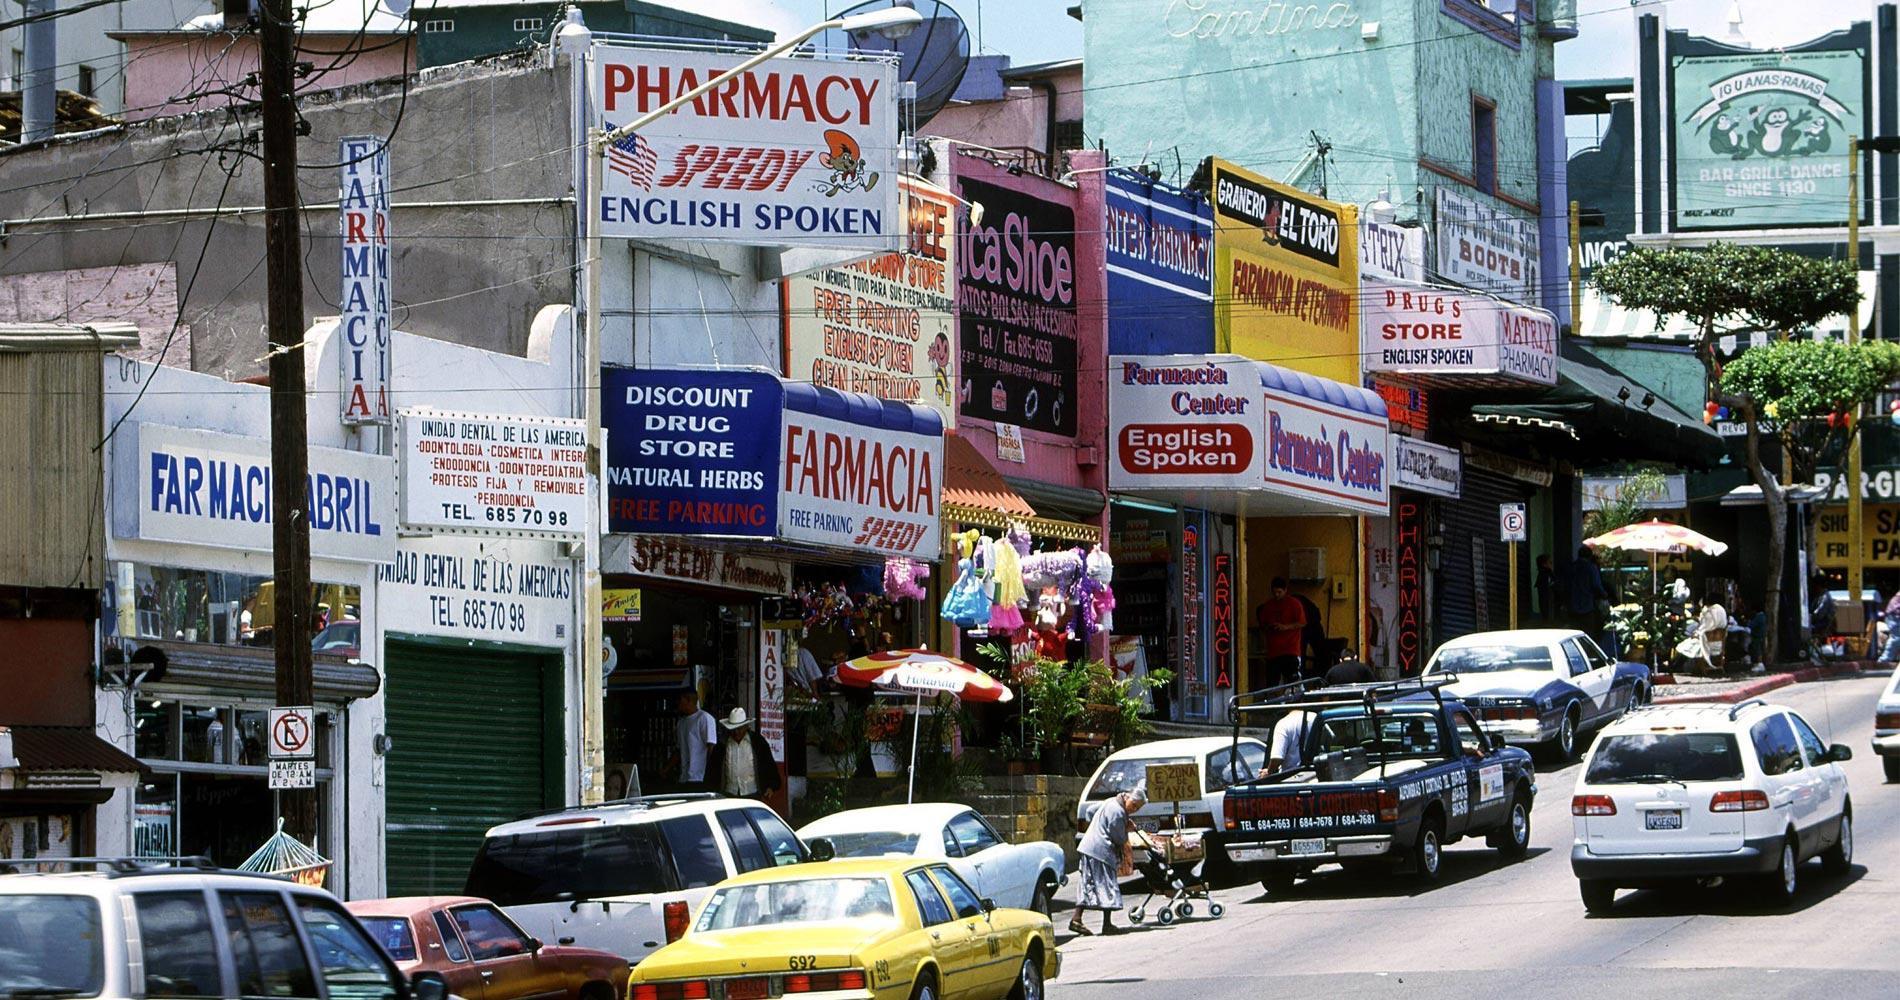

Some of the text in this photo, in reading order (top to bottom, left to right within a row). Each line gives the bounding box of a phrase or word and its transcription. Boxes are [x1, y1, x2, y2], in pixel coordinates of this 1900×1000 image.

[1165, 0, 1359, 38] Cantina
[604, 63, 880, 126] PHARMACY
[657, 144, 815, 192] SPEEDY
[1725, 182, 1772, 197] SINCE
[601, 196, 882, 235] ENGLISH SPOKEN
[907, 194, 947, 262] REE
[1217, 177, 1339, 256] GRANERO EL TORO
[1105, 203, 1211, 281] NTER PHARMACY
[960, 211, 1072, 305] ica Shoe
[1459, 238, 1521, 281] BOOTS
[344, 143, 371, 416] FARMACIA
[375, 144, 388, 417] FARMACIA
[868, 252, 906, 285] CANDY
[908, 257, 945, 294] STORE
[1232, 258, 1295, 316] FARMACIA
[853, 274, 869, 295] TODO
[870, 279, 887, 300] PARA
[889, 284, 902, 302] SUS
[813, 285, 921, 343] FREE PARKING
[1385, 289, 1461, 318] DRUGS
[1382, 323, 1462, 340] STORE
[1501, 310, 1553, 355] MATRIX
[823, 324, 914, 375] ENGLISH SPOKEN
[1383, 349, 1473, 365] ENGLISH SPOKEN
[1503, 345, 1553, 379] PHARMACY
[812, 357, 847, 391] CLEAN
[1121, 361, 1229, 386] Farmacia
[626, 386, 752, 408] DISCOUNT
[1171, 391, 1250, 416] Center
[421, 420, 586, 448] UNIDAD DENTAL DE LAS AMERICA
[645, 415, 730, 432] DRUG
[490, 445, 543, 461] COSMETICA
[639, 440, 735, 458] STORE
[1128, 429, 1233, 450] English
[1269, 410, 1335, 483] Farmacia
[1337, 428, 1384, 493] Center
[433, 457, 491, 473] ENDODONCIA
[784, 424, 935, 516] FARMACIA
[1133, 450, 1237, 469] Spoken
[151, 451, 271, 524] FARMACI
[432, 473, 585, 495] PROTESIS FIJA Y REMOVIBLE
[607, 467, 764, 490] NATURAL HERBS
[1814, 470, 1900, 499] BAR-G
[441, 503, 568, 526] TEL. 685 70 98
[477, 493, 536, 508] PERIODONCIA
[610, 498, 767, 526] FREE PARKING
[790, 508, 854, 534] FREE PARKING
[854, 516, 928, 553] SPEEDY
[1508, 516, 1517, 529] E
[1821, 513, 1848, 533] SHO
[631, 536, 716, 583] SPEEDY
[1826, 541, 1865, 557] FR
[424, 553, 466, 590] DENTAL
[473, 558, 487, 592] DE
[492, 561, 513, 594] LAS
[518, 564, 570, 600] AMERICAS
[1400, 504, 1418, 671] PHARMACY
[430, 595, 525, 632] TEL. 685 70 98
[1214, 555, 1231, 688] FARMACIA
[275, 762, 309, 771] MARTES
[1168, 767, 1196, 778] ZONA
[272, 779, 277, 787] A
[282, 779, 288, 787] 2
[1155, 786, 1195, 800] TAXIS
[1240, 821, 1255, 831] TEL.
[1257, 819, 1291, 830] 684-7663
[1299, 817, 1333, 828] 684-7678
[1341, 814, 1376, 825] 684-7681
[789, 955, 817, 970] 692
[875, 960, 891, 982] 692
